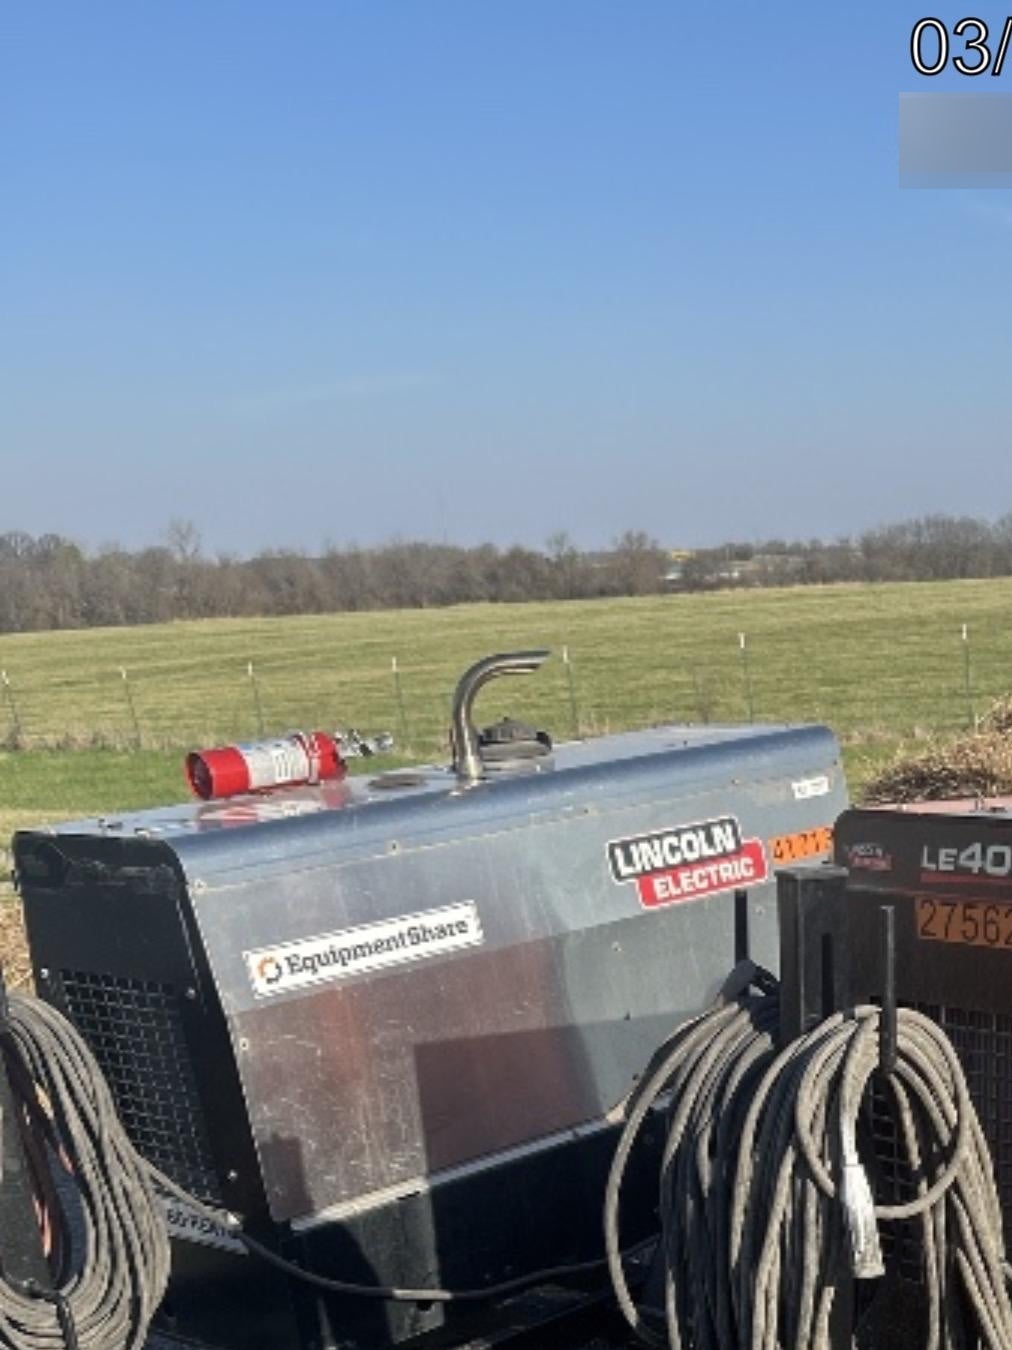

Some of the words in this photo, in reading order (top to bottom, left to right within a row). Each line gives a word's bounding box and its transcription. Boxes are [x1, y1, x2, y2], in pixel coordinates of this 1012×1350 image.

[613, 822, 736, 876] LINCOLN
[653, 857, 754, 900] ELECTRIC
[285, 918, 469, 975] EquipmentShare
